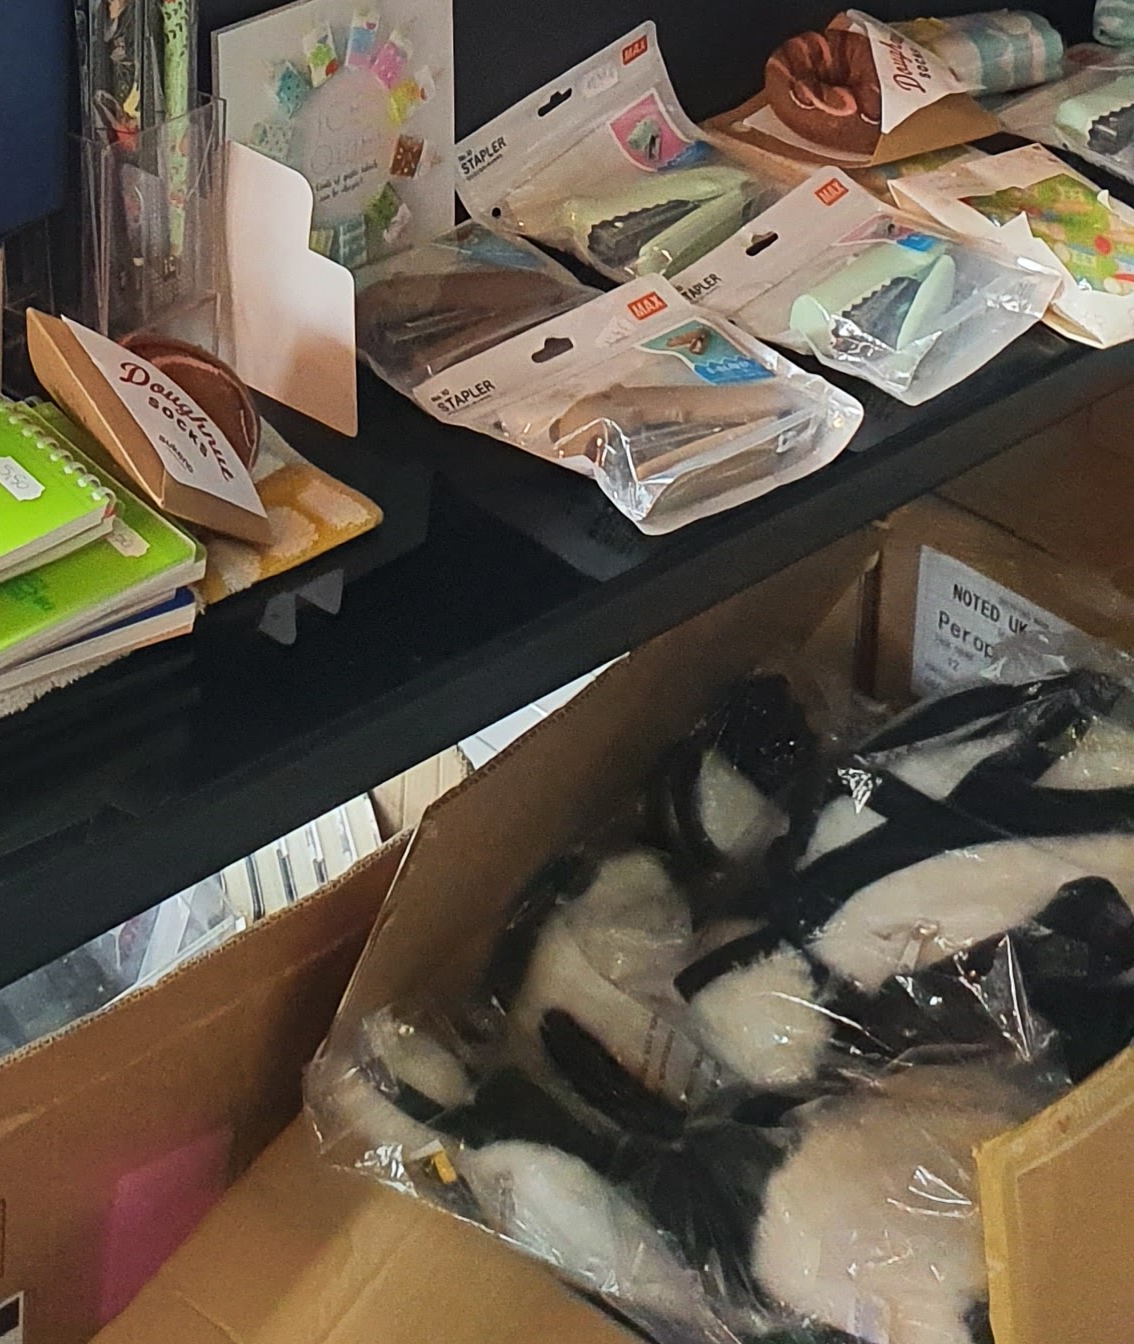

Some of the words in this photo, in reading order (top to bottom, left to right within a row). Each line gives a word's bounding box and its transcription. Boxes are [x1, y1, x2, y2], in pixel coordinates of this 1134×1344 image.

[461, 136, 507, 175] STAPLER
[681, 273, 722, 300] TAPLER
[631, 294, 664, 317] MAX
[437, 380, 495, 412] STAPLER
[148, 397, 208, 457] SOCKS
[952, 584, 1000, 623] NOTED
[1008, 615, 1028, 634] UK
